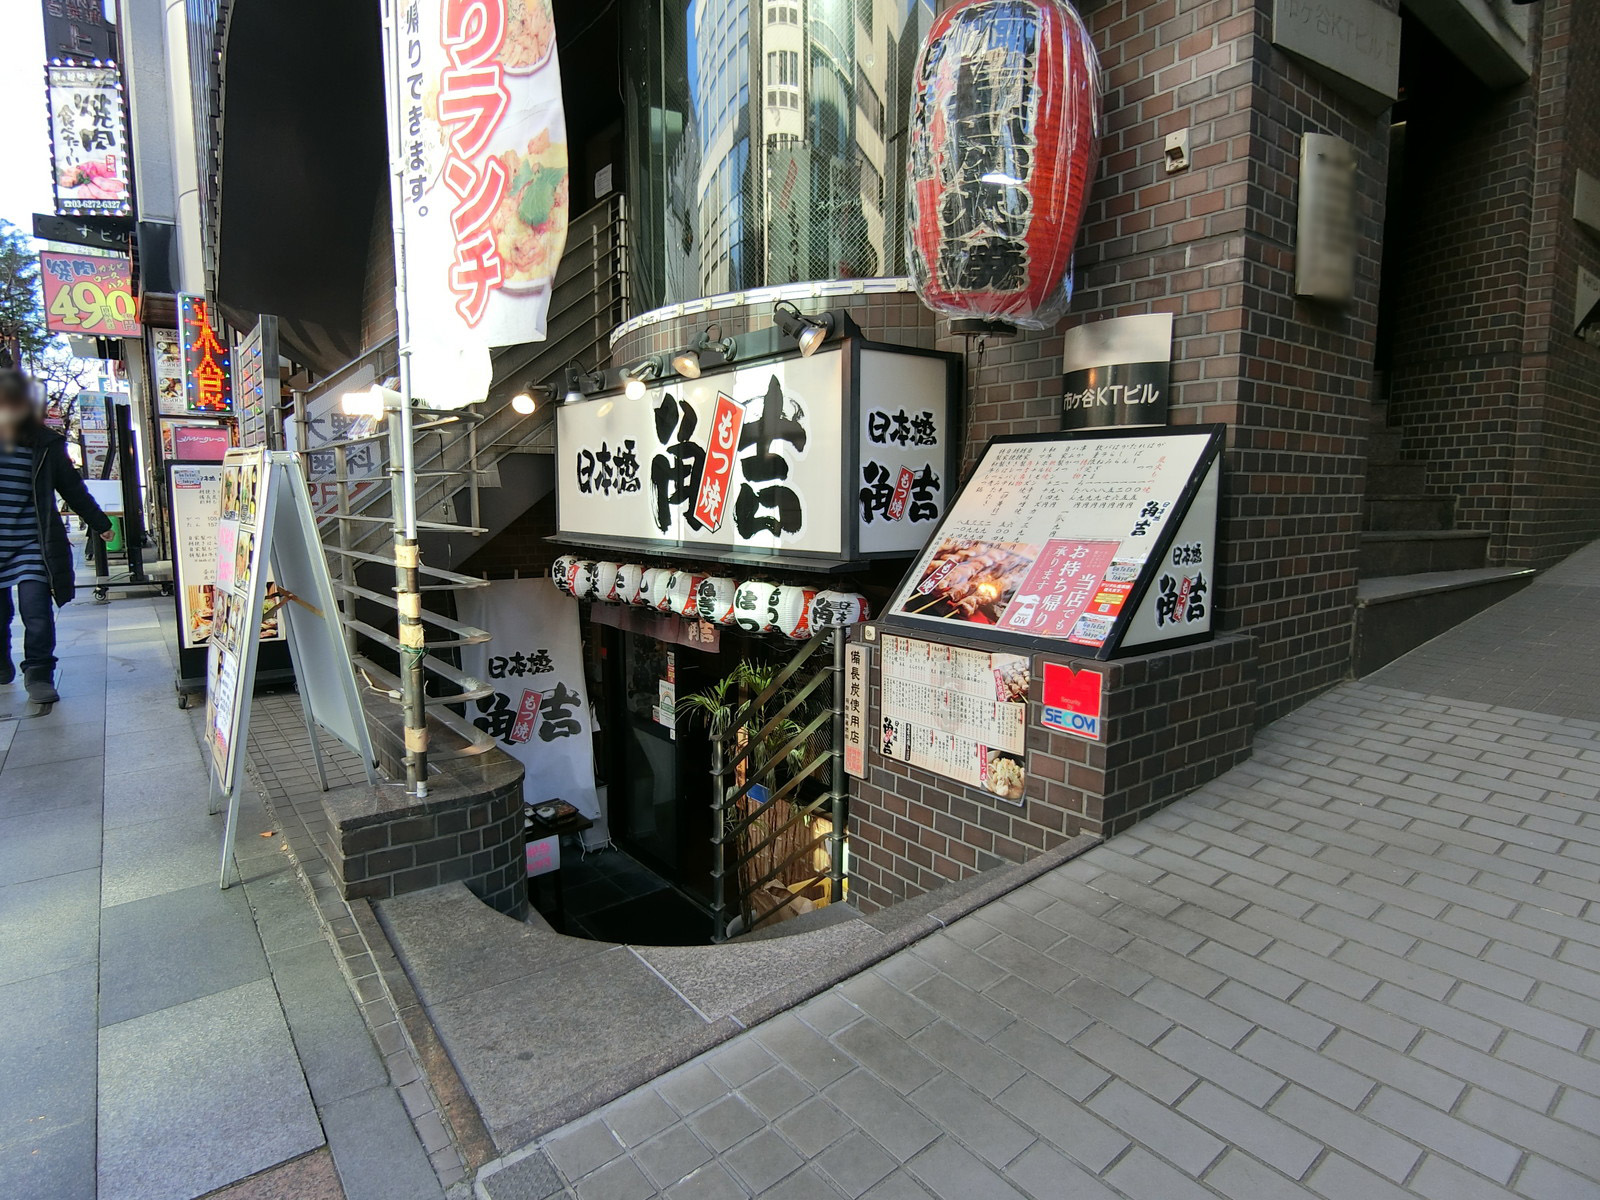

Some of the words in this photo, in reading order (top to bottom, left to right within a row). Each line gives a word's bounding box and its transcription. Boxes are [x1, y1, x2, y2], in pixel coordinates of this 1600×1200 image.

[74, 94, 115, 152] 焼肉
[46, 258, 98, 283] 焼肉
[49, 281, 136, 330] 490
[868, 408, 938, 447] 日本橋
[577, 440, 643, 496] 日本橋
[650, 374, 807, 540] 角吉
[698, 409, 739, 522] もつ焼
[859, 461, 941, 524] 角吉
[888, 472, 914, 520] もつ焼
[1130, 500, 1158, 537] 角吉
[920, 562, 955, 595] もつ焼
[1034, 546, 1068, 592] 承ります
[1172, 544, 1203, 566] 日本橋
[735, 588, 762, 632] はつ
[1034, 545, 1089, 628] お持ち帰り
[1056, 574, 1096, 630] 当店でも
[1156, 572, 1207, 627] 角吉
[1175, 578, 1190, 622] もつ焼
[1014, 616, 1028, 624] OK
[487, 649, 555, 679] 日本橋
[473, 681, 582, 746] 角吉
[512, 696, 541, 741] もつ焼
[850, 650, 861, 745] 備長炭使用店
[1045, 707, 1096, 733] SECOM
